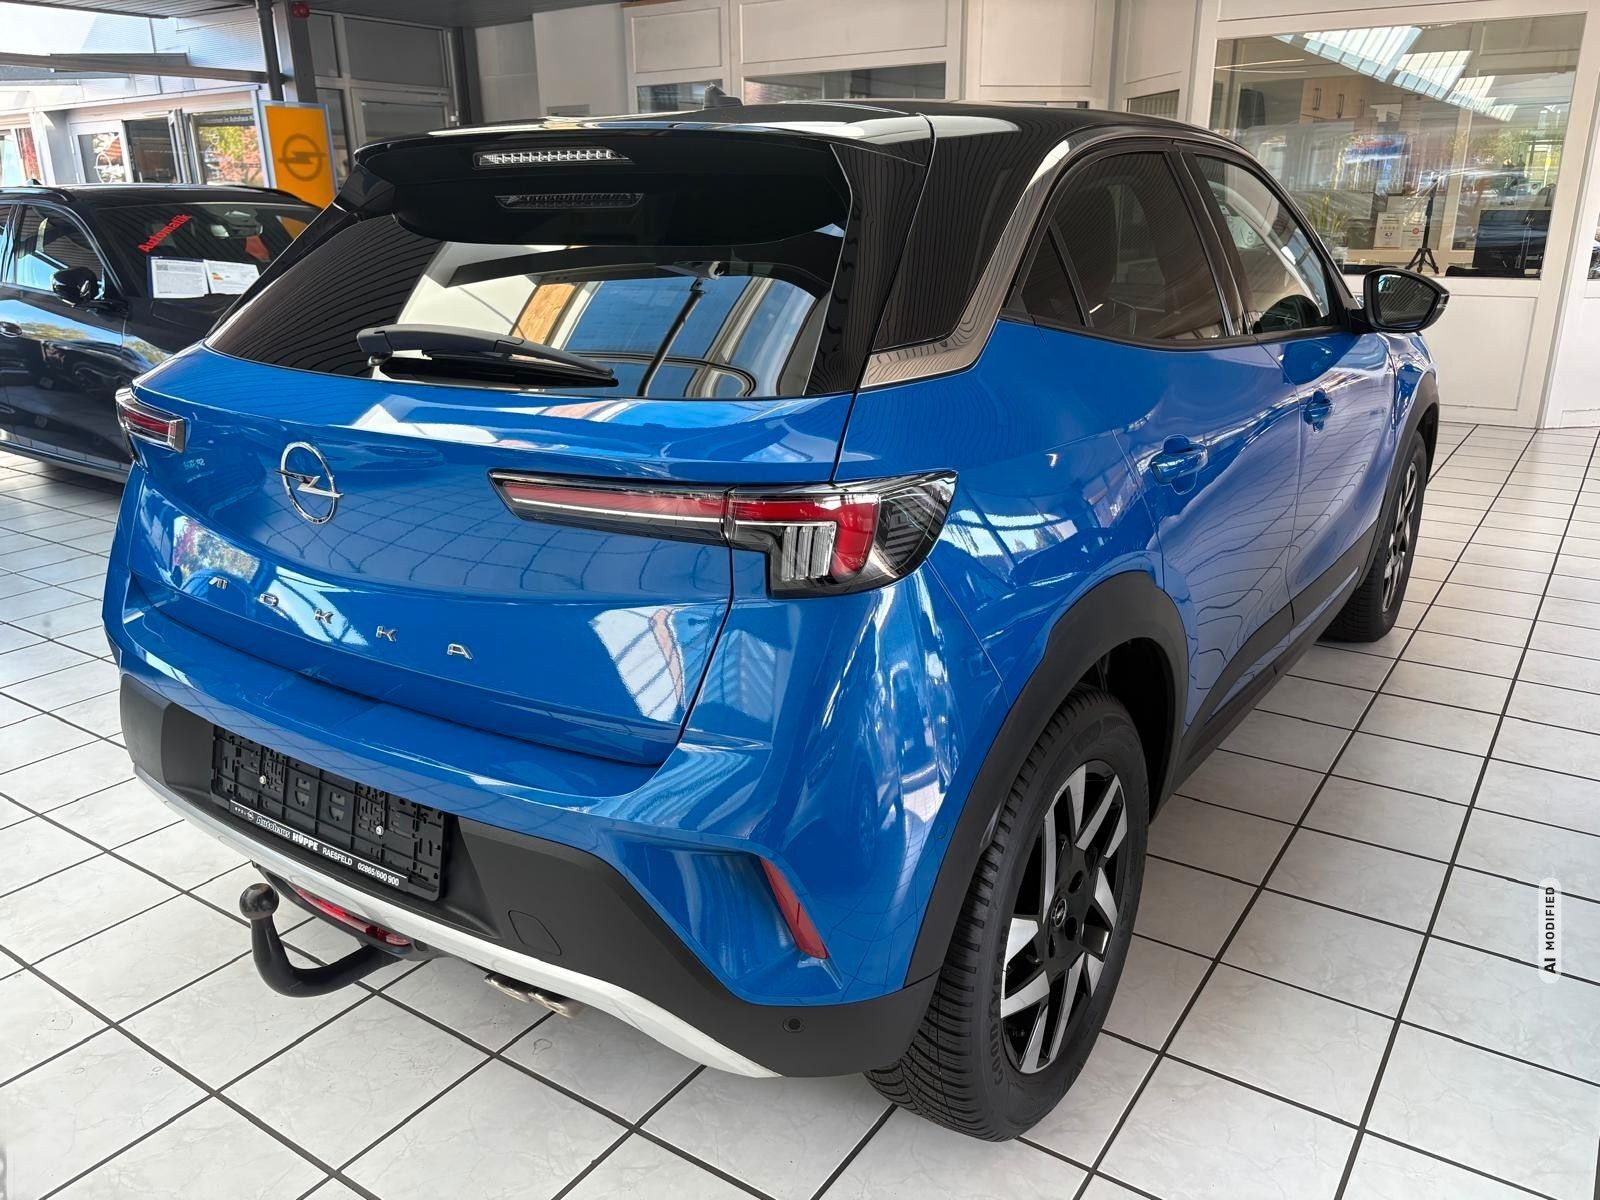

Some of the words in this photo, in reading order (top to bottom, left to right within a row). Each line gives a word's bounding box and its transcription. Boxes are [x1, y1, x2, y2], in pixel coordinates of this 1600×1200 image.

[136, 214, 193, 253] Automatik
[208, 575, 473, 661] MOKKA
[256, 816, 291, 839] Autohaus
[322, 847, 353, 866] RAESFELD
[387, 875, 400, 887] 900
